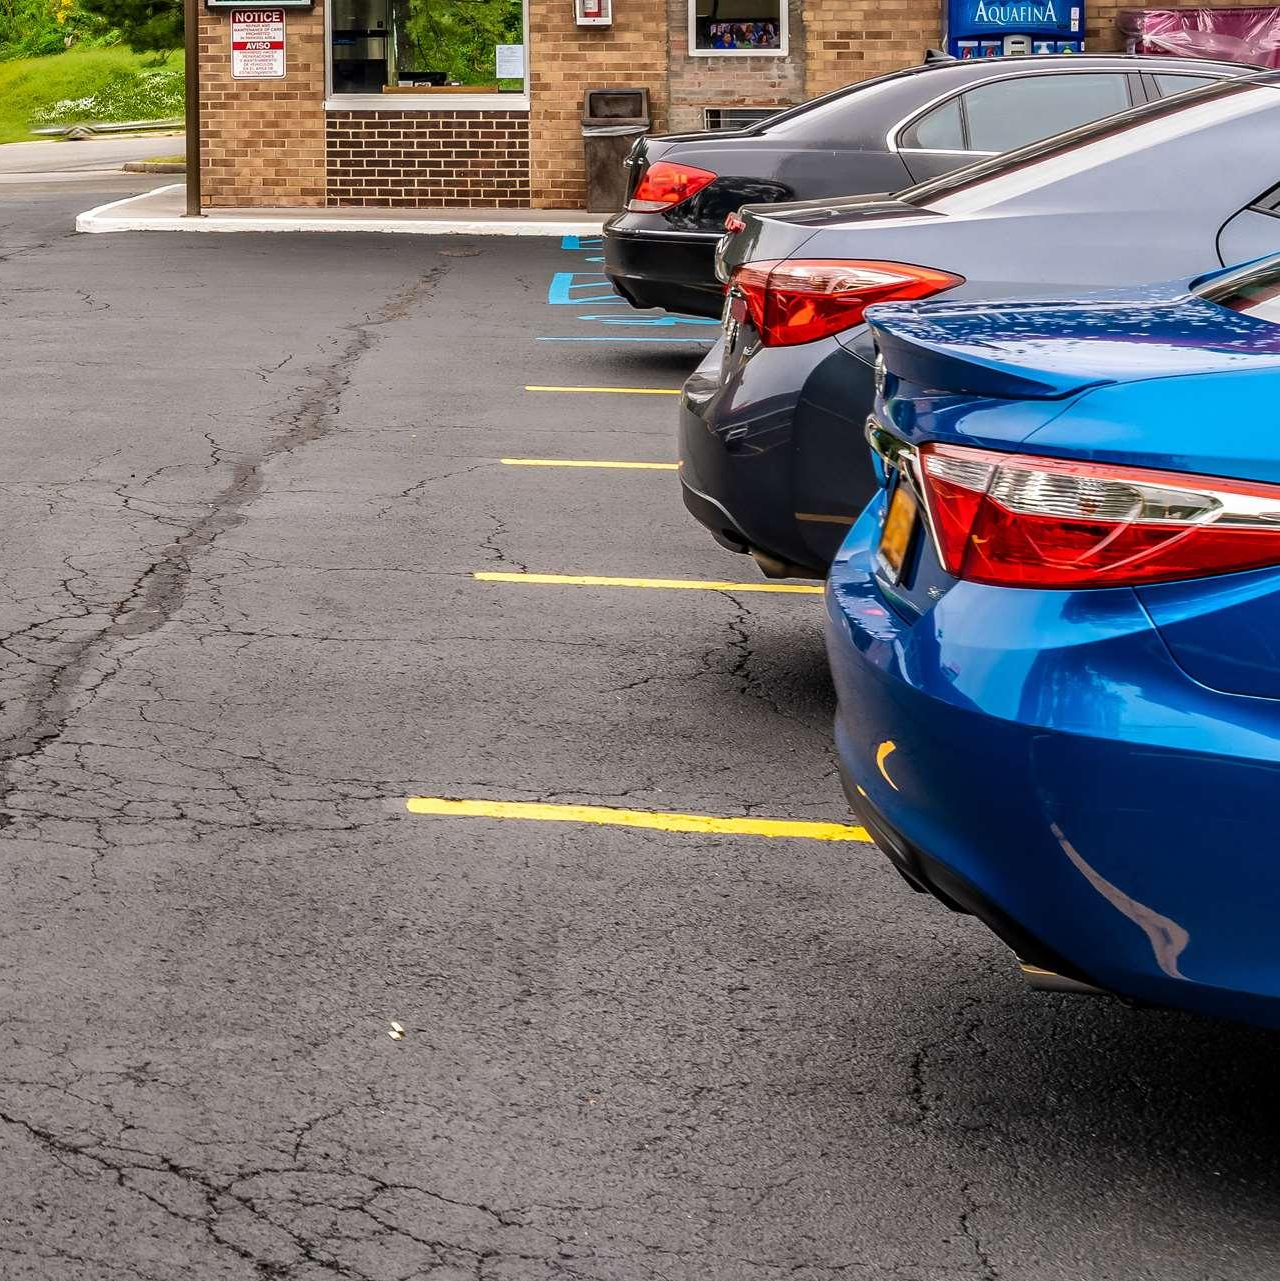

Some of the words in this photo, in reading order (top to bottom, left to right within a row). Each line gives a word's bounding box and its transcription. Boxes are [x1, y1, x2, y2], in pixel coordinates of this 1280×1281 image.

[235, 11, 281, 23] NOTICE
[974, 0, 1057, 26] AQUAFINA
[245, 41, 271, 50] AVISO
